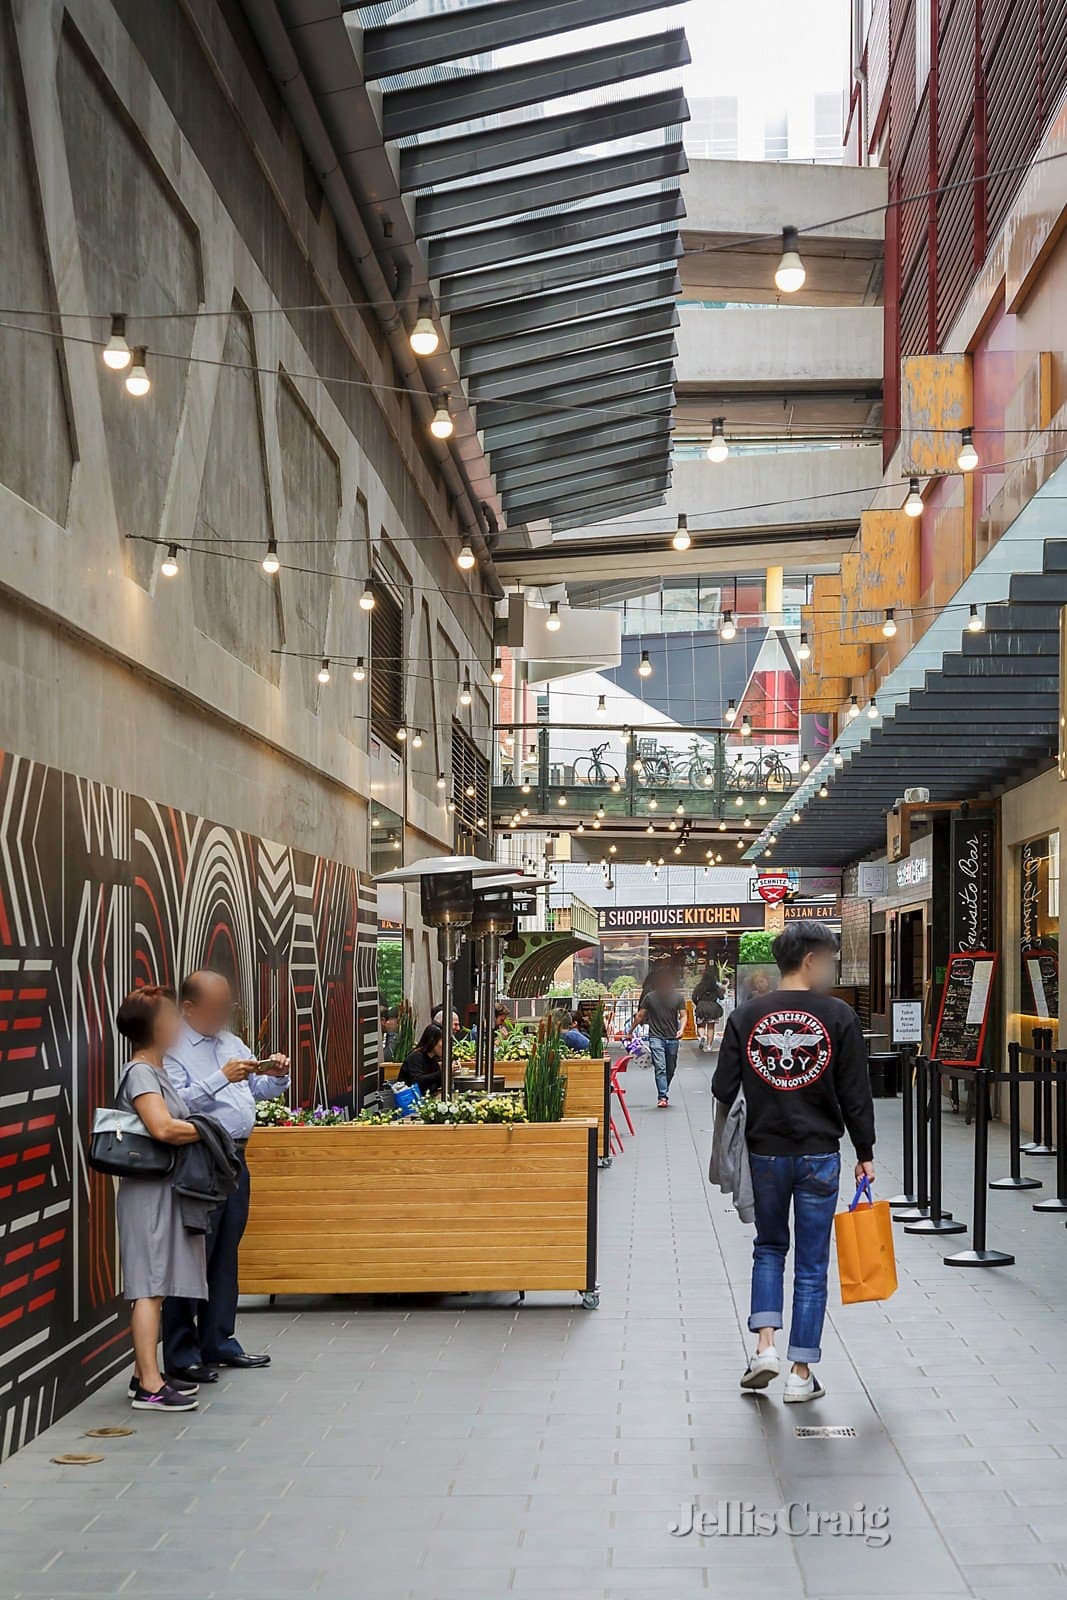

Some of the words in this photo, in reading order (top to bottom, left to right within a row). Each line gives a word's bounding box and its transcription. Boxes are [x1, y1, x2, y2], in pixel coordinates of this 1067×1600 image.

[958, 834, 979, 878] Bar
[512, 902, 529, 912] NE
[785, 907, 813, 918] ASIAN
[608, 907, 740, 926] SHOPHOUSEKITCHEN
[767, 1055, 811, 1071] BOY
